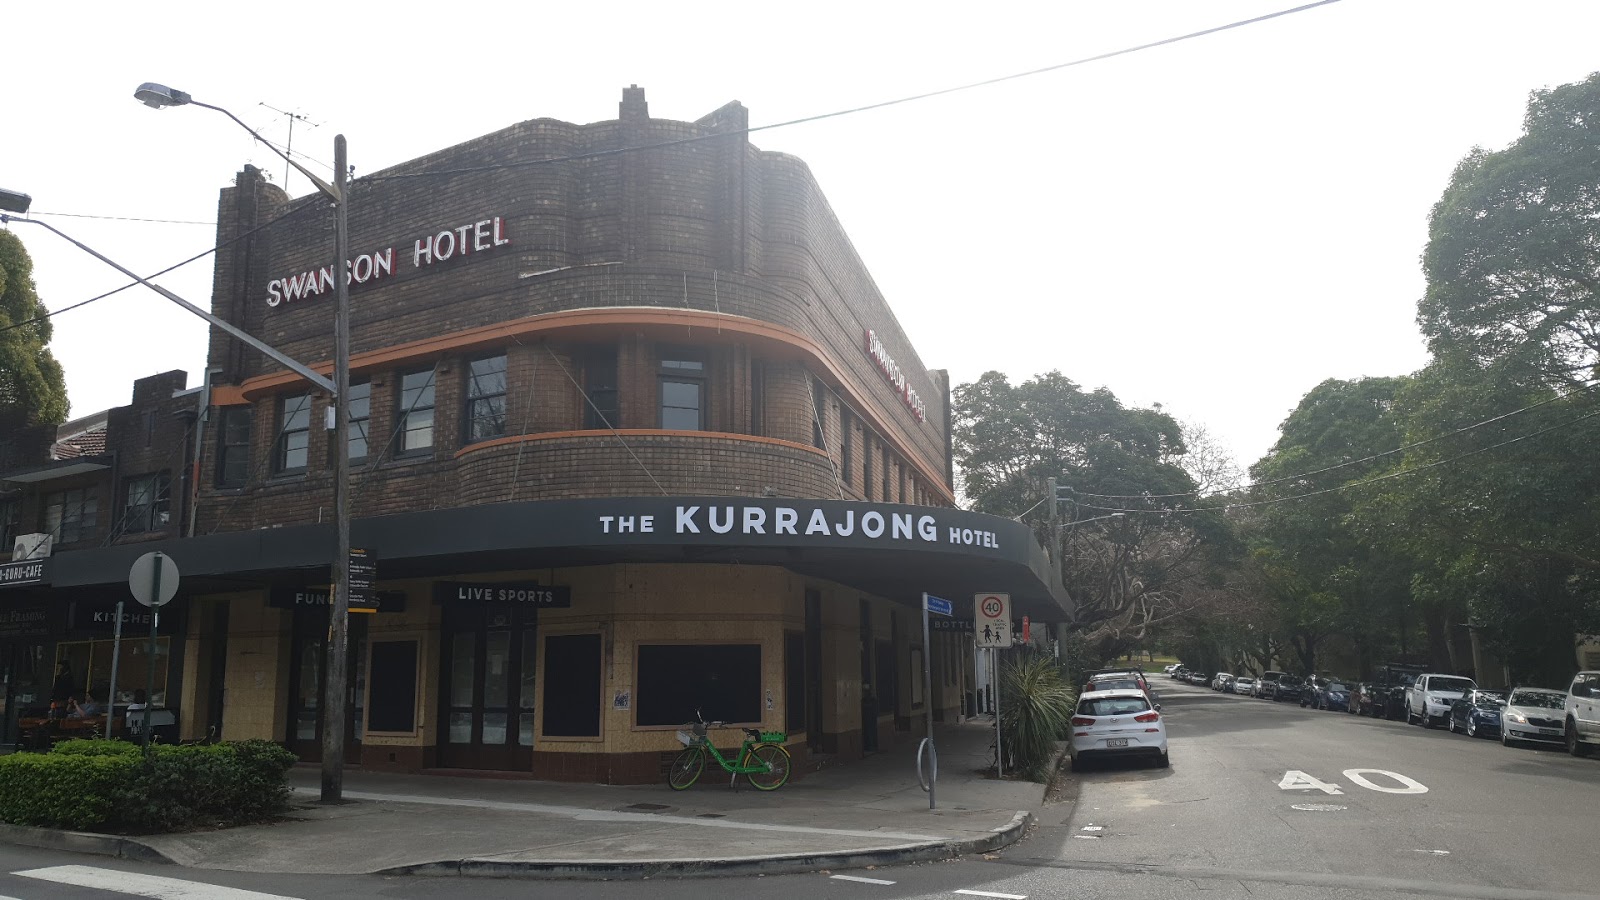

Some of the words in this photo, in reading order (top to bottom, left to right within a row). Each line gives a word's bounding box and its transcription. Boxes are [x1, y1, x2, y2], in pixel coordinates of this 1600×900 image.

[413, 216, 509, 268] HOTEL
[868, 329, 905, 392] SWANSON
[906, 383, 926, 423] HOTEL
[599, 515, 655, 533] THE
[675, 505, 938, 542] KURRAJONG
[948, 526, 1000, 550] HOTEL
[458, 586, 493, 601] LIVE
[497, 588, 554, 603] SPORTS
[93, 611, 152, 624] KITCHE
[985, 601, 1000, 613] 40
[934, 620, 975, 629] BOTTL
[1278, 768, 1429, 795] 40
